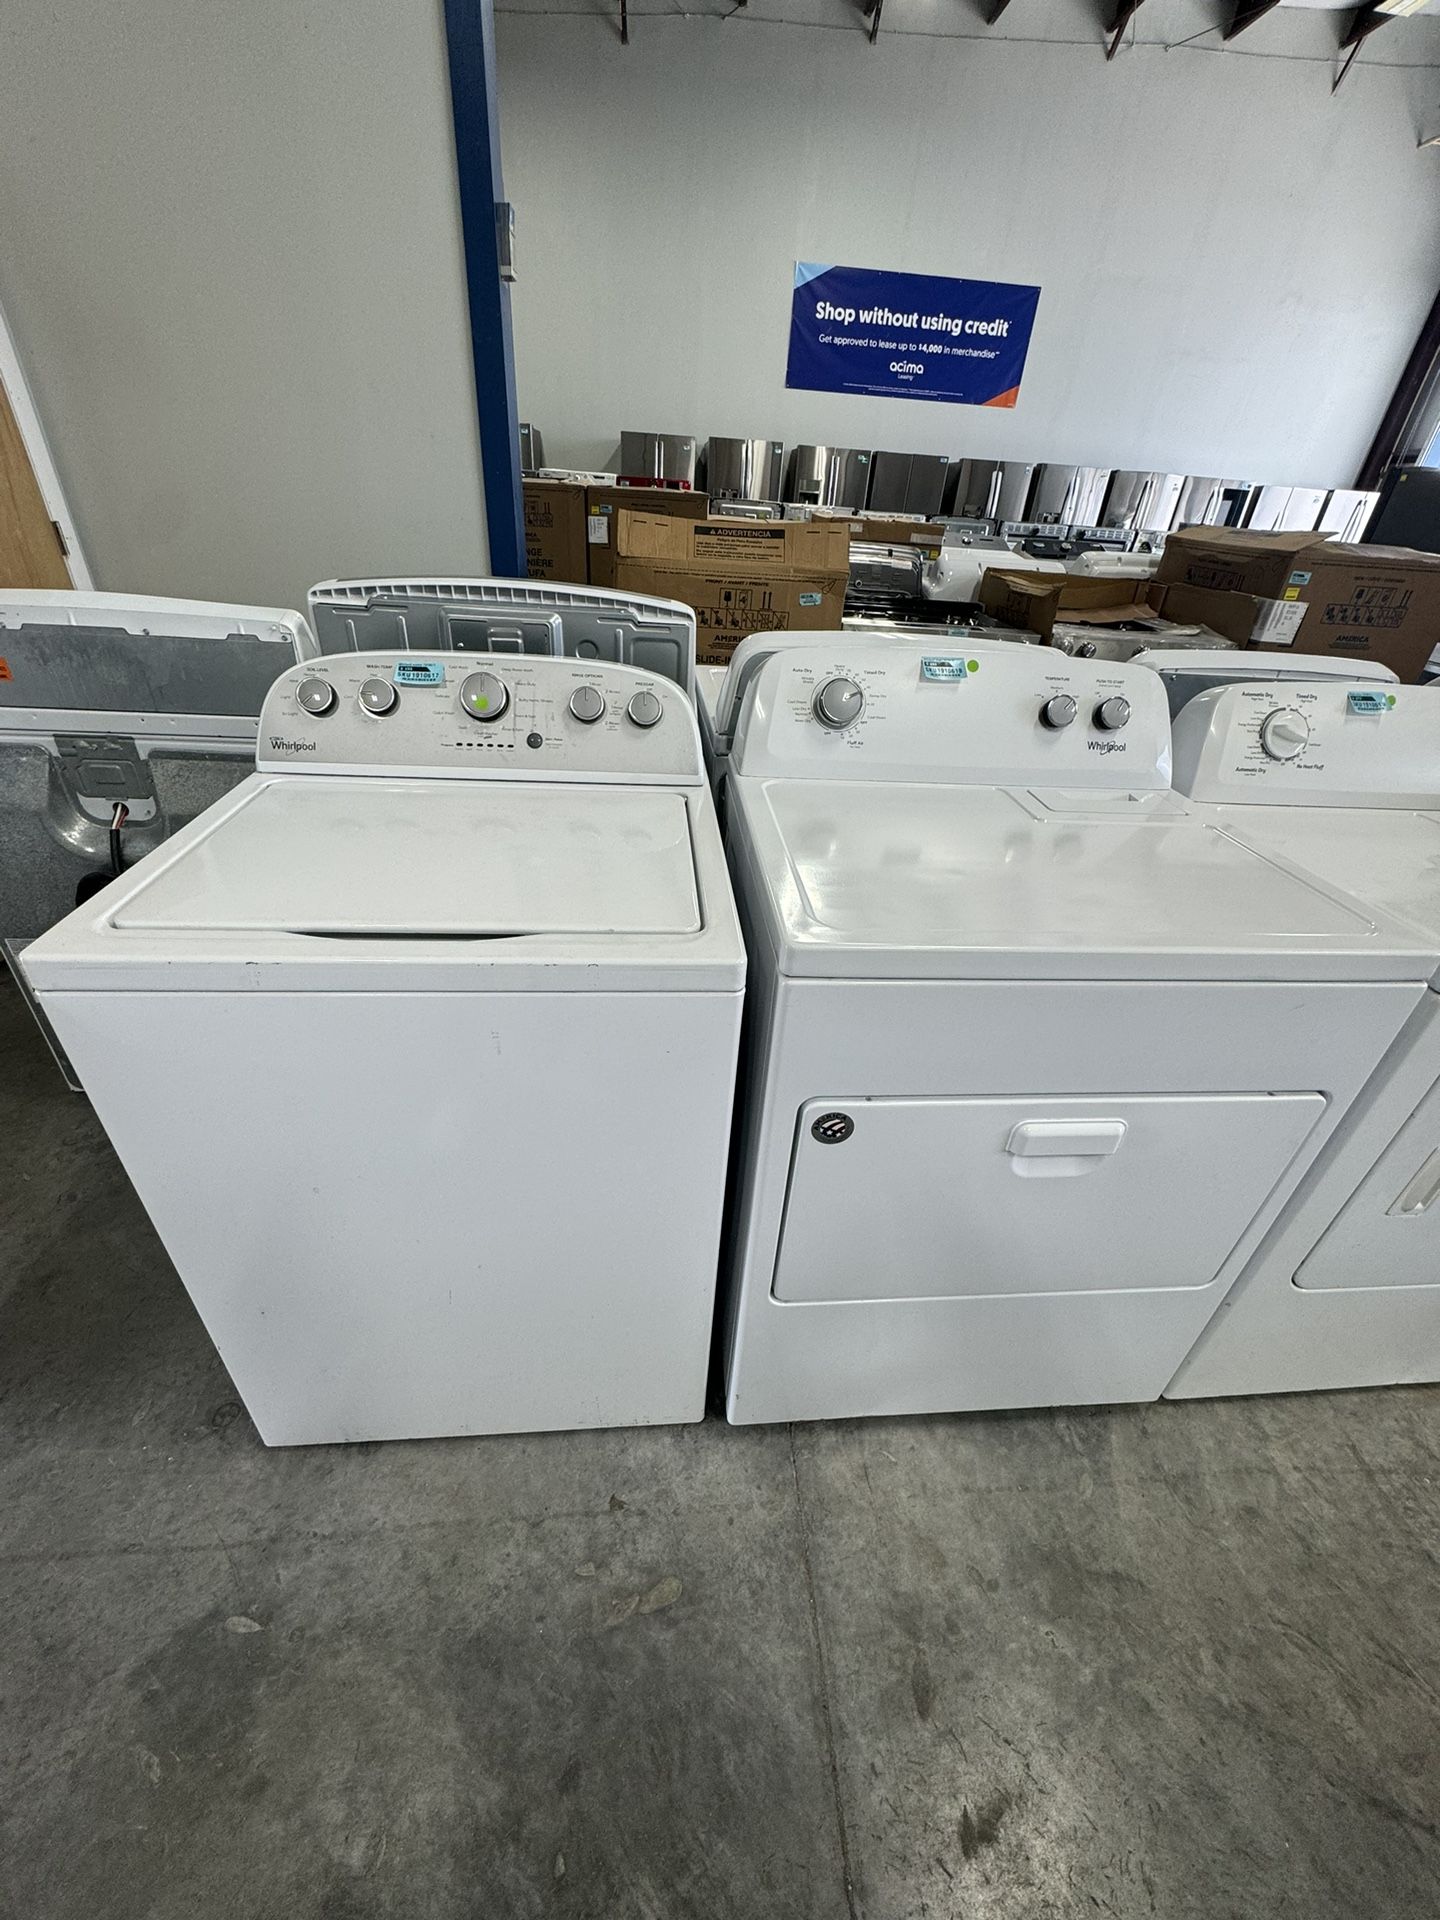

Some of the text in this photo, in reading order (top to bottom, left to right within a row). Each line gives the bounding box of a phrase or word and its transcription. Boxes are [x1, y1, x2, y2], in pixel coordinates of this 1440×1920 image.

[815, 301, 856, 326] Shop
[859, 307, 918, 329] without
[921, 313, 962, 336] using
[819, 334, 832, 343] Get
[833, 336, 868, 347] approved
[878, 340, 897, 349] lease
[898, 343, 908, 352] up
[909, 343, 917, 351] to
[918, 343, 942, 354] $4,000
[943, 345, 951, 354] in
[889, 360, 924, 374] acima
[717, 528, 772, 538] ADVERTENCIA
[271, 740, 316, 752] Whirlpool
[1087, 741, 1126, 753] Whirlpool
